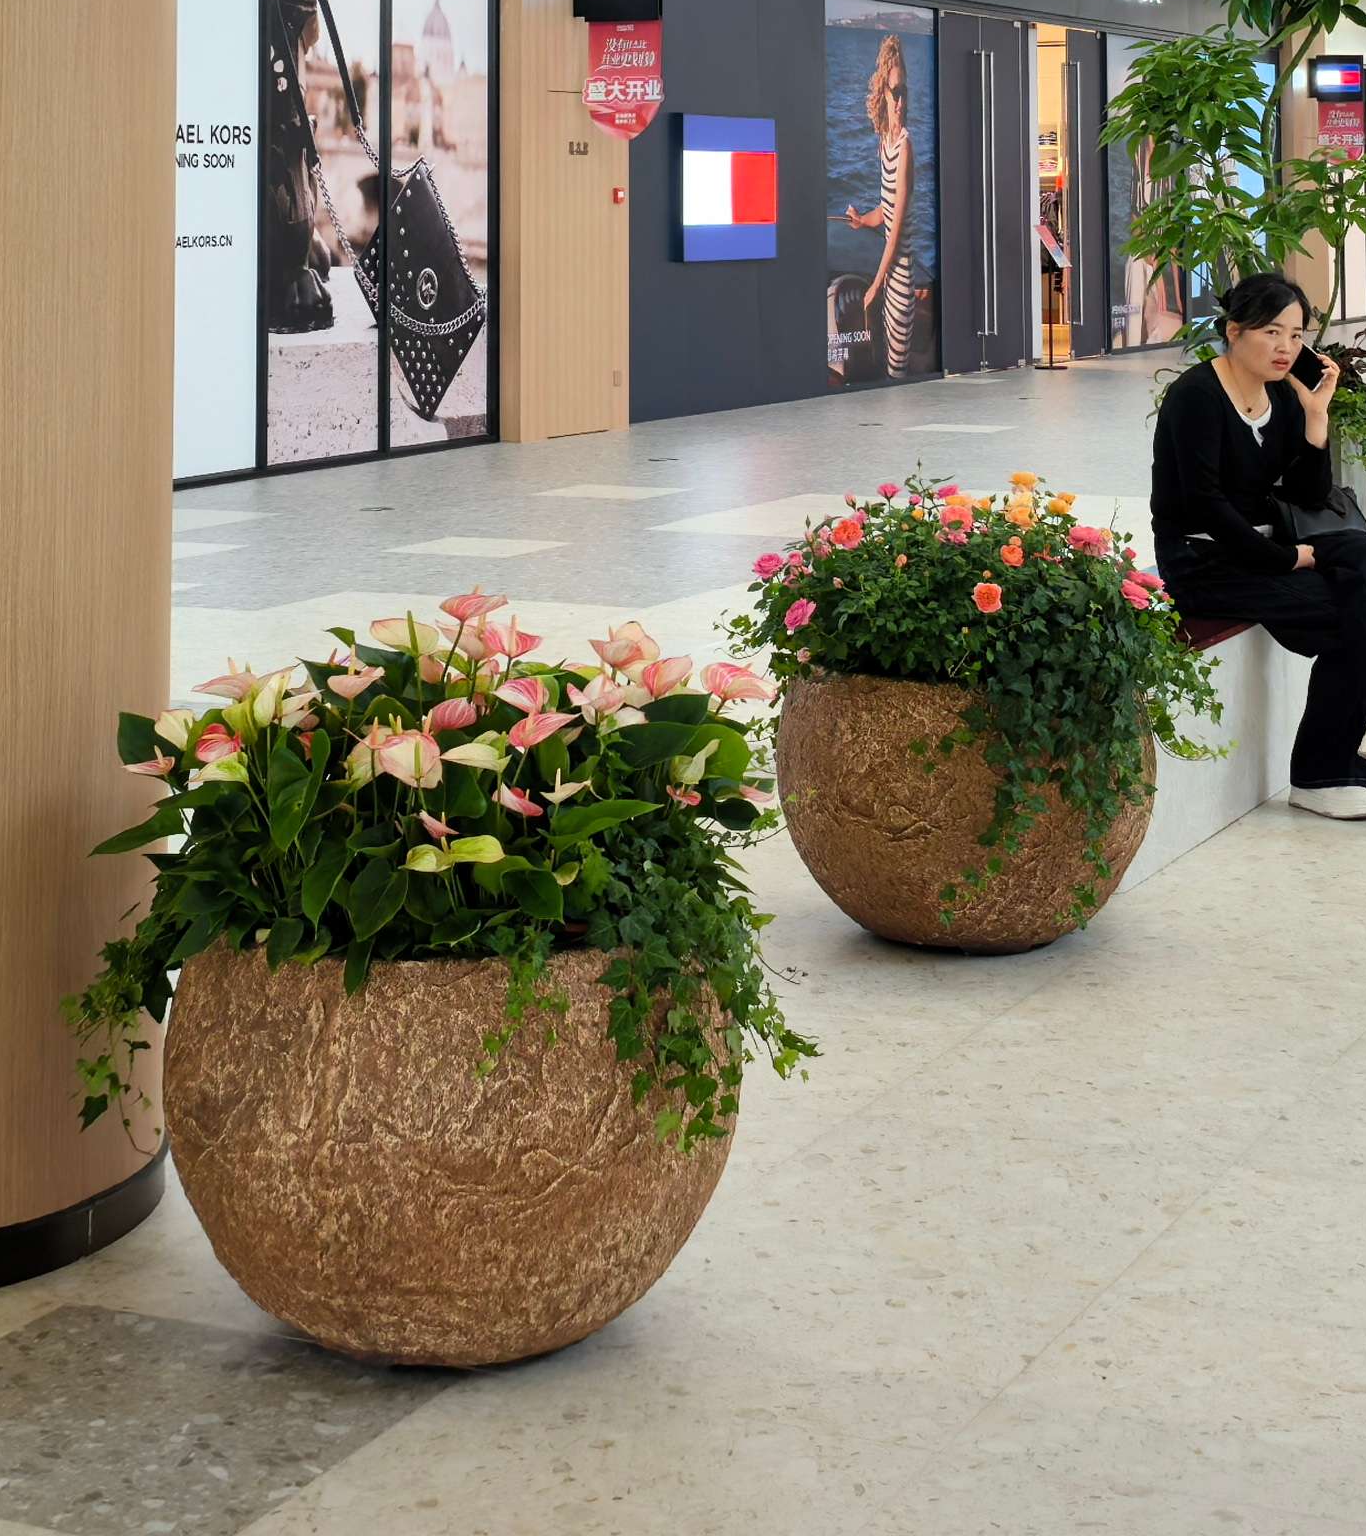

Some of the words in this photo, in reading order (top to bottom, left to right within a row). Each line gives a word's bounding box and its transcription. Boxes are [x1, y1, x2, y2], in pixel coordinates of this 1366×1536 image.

[586, 82, 661, 102] 盛大开业
[175, 123, 204, 144] AEL
[210, 124, 252, 145] KORS
[203, 153, 235, 169] SOON
[853, 330, 871, 343] SOON
